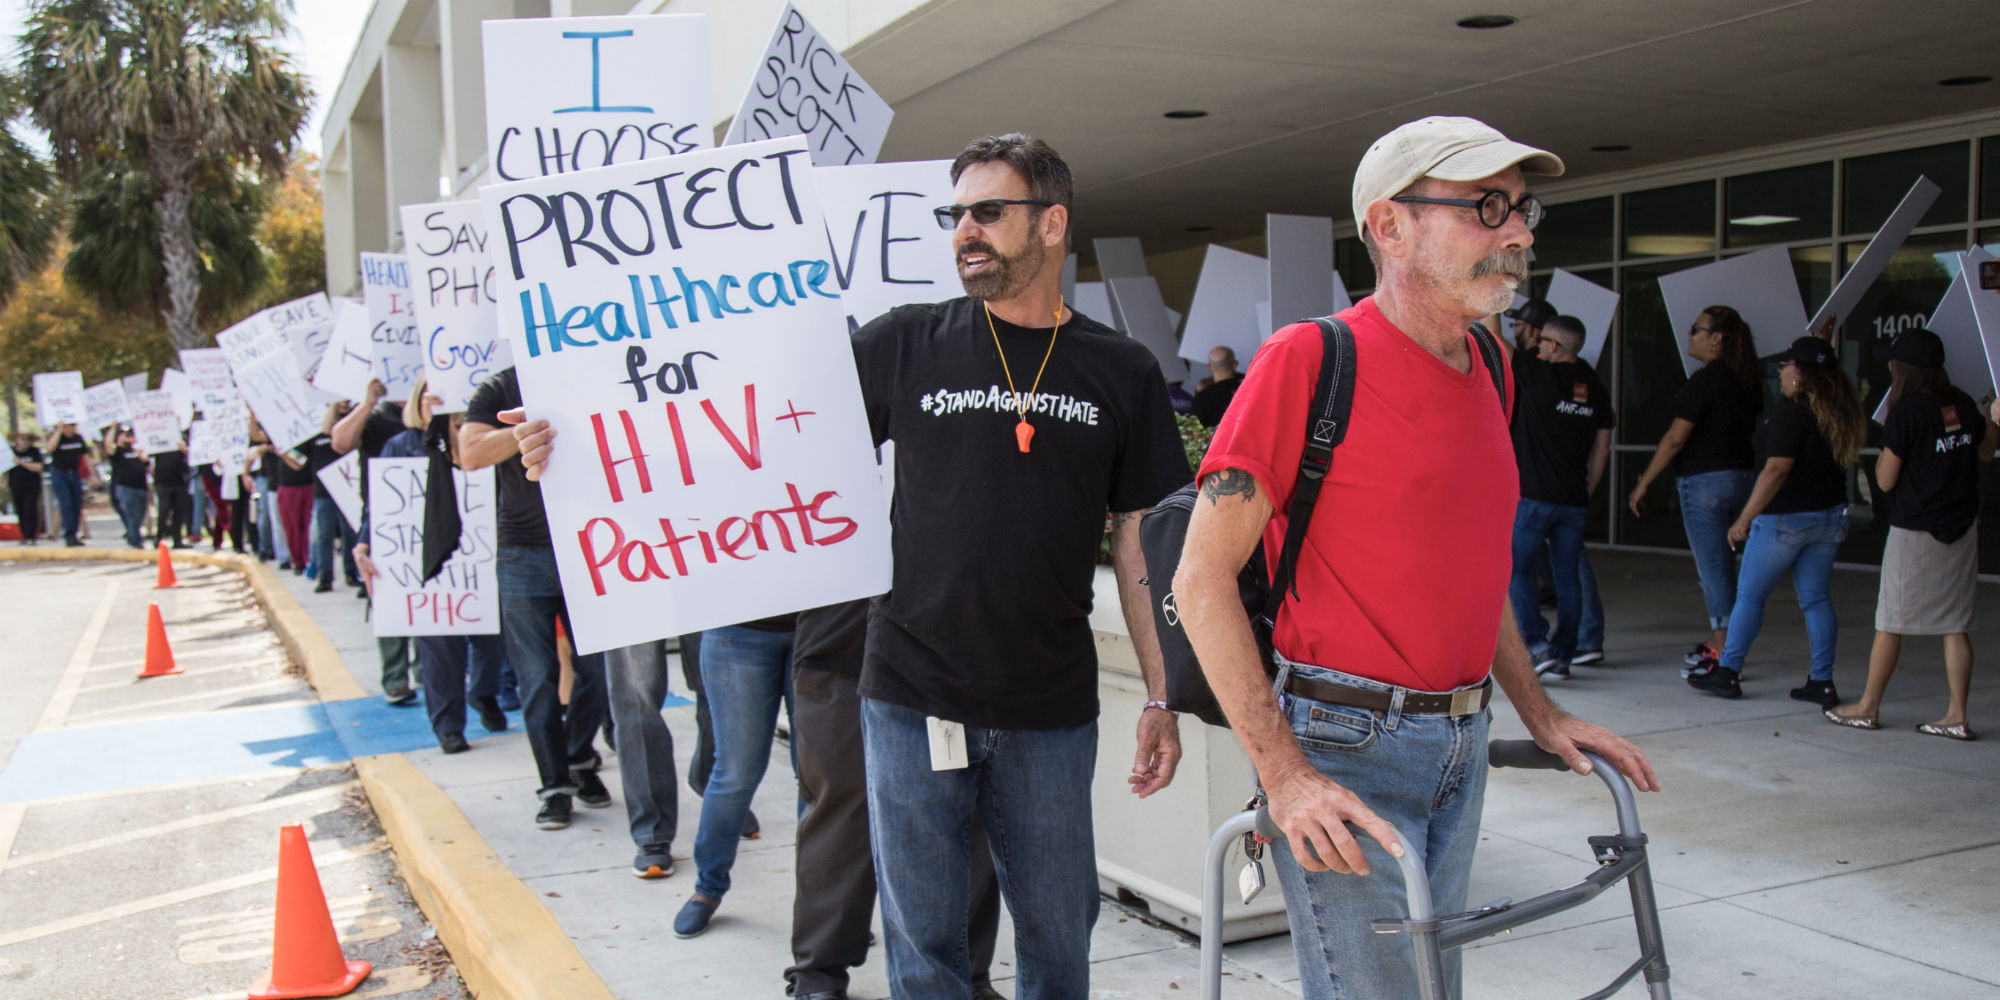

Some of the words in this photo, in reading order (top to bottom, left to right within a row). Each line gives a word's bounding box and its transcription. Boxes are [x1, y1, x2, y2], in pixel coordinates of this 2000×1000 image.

[552, 29, 655, 115] I
[777, 8, 866, 123] RICK
[756, 55, 865, 166] SCOTT
[417, 210, 488, 257] SAV
[500, 149, 809, 281] PROTECT
[823, 190, 935, 291] VE
[269, 300, 320, 331] SAVE
[519, 258, 841, 358] Healthcare
[1873, 313, 1927, 339] 1400
[618, 345, 719, 402] for
[382, 465, 485, 515] SAE
[375, 523, 494, 564] STADS
[577, 482, 859, 597] Patients
[406, 591, 482, 627] PHC
